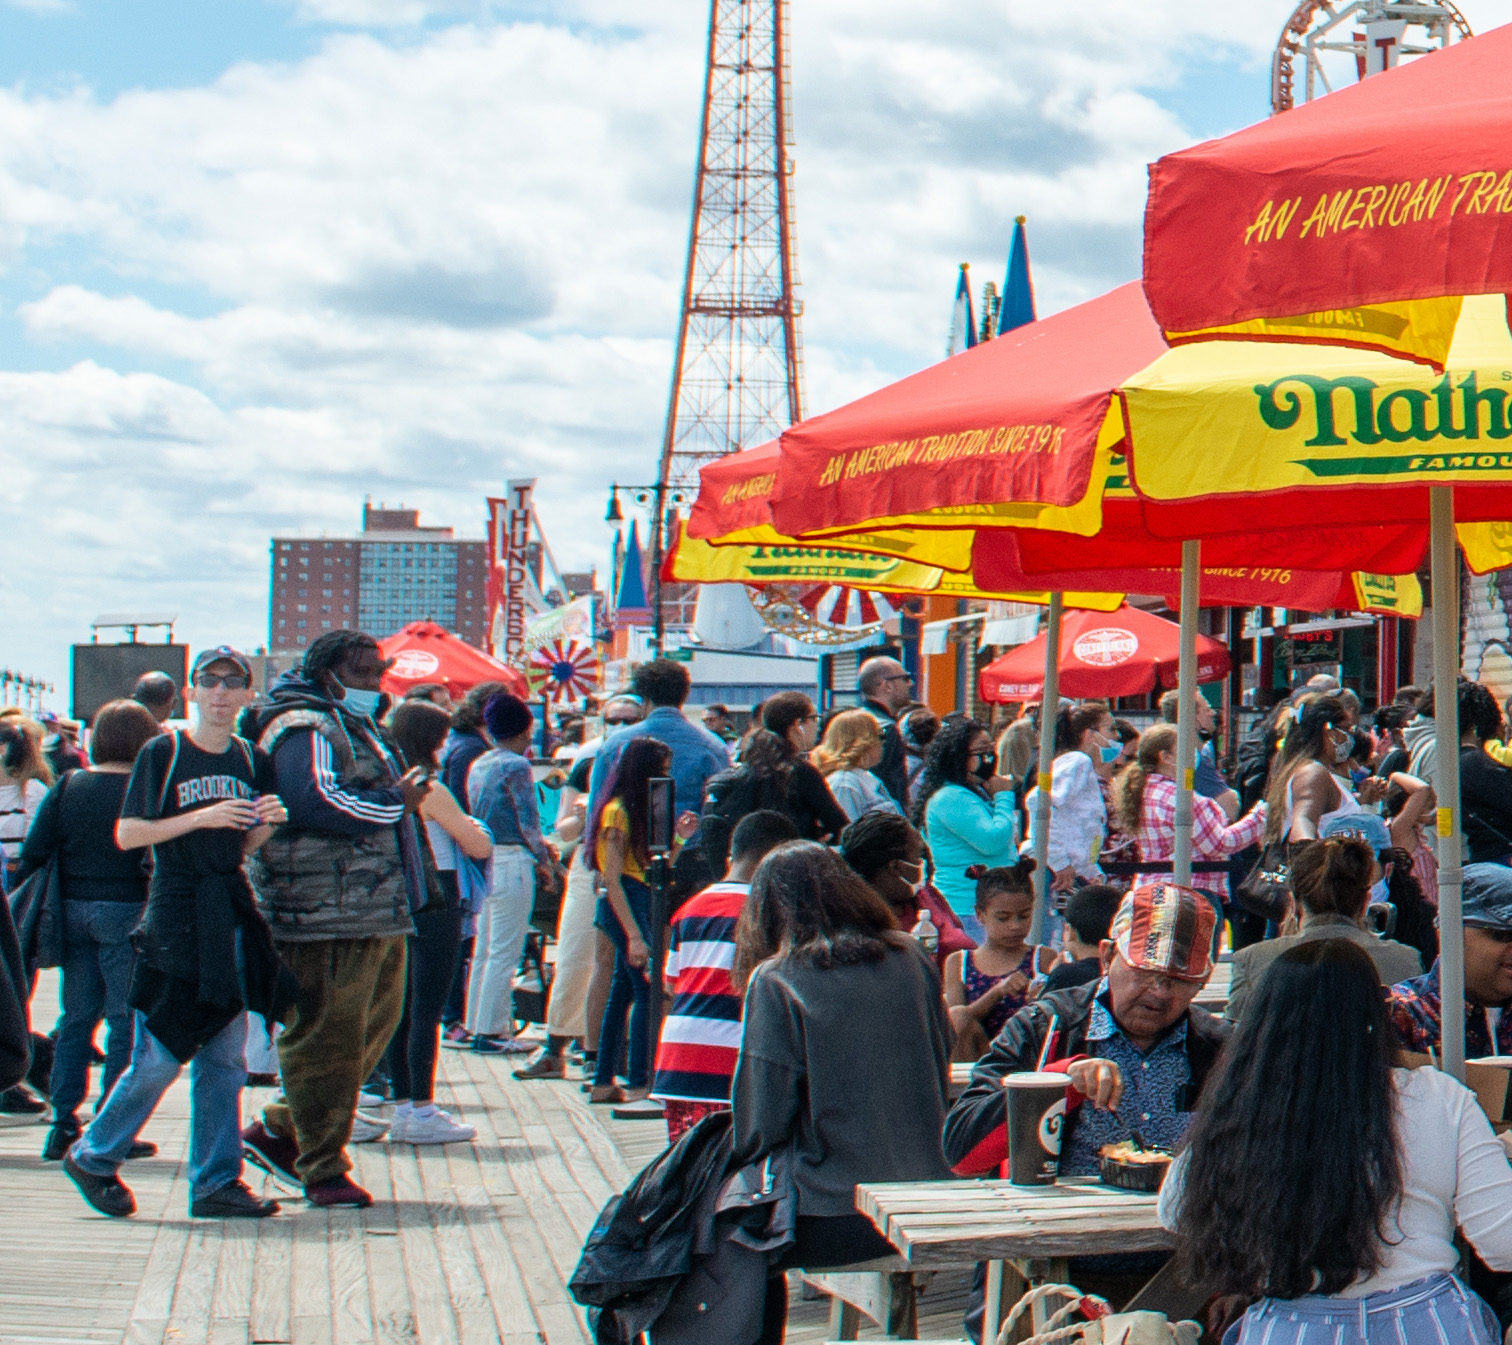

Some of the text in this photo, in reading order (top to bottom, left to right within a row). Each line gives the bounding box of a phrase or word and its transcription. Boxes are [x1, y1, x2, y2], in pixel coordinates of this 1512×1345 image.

[1244, 196, 1301, 244] AN
[1299, 174, 1452, 238] AMERICAN
[819, 424, 1066, 486] AN AMERICAN TRADITION SINCE 1916
